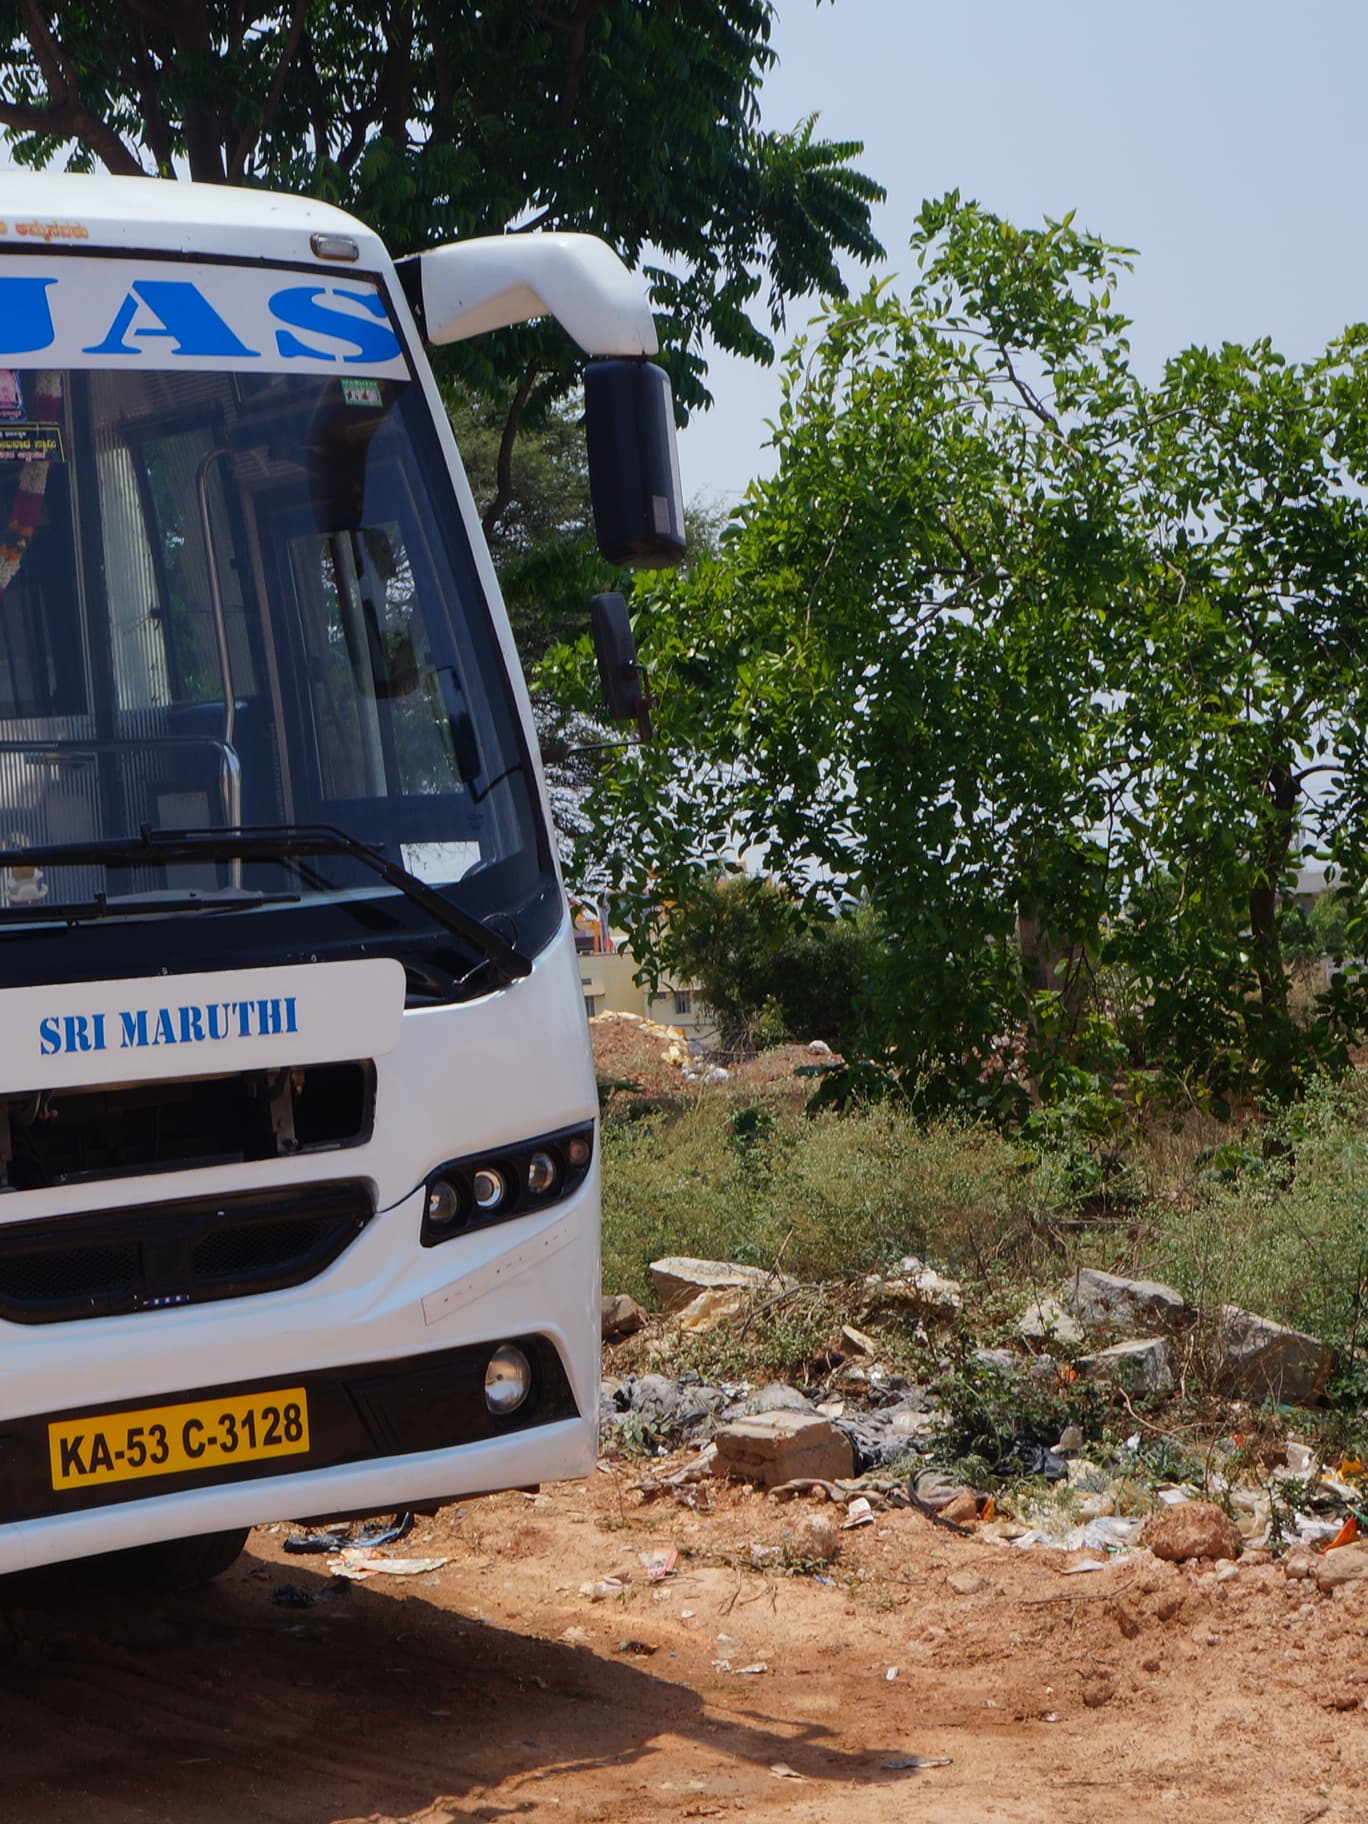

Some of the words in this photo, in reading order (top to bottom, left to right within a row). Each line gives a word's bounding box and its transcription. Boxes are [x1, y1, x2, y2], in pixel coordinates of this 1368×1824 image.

[39, 1013, 106, 1055] SRI
[119, 997, 298, 1048] MARUTHI
[59, 1424, 169, 1478] KA-53
[182, 1402, 304, 1459] C-3128
